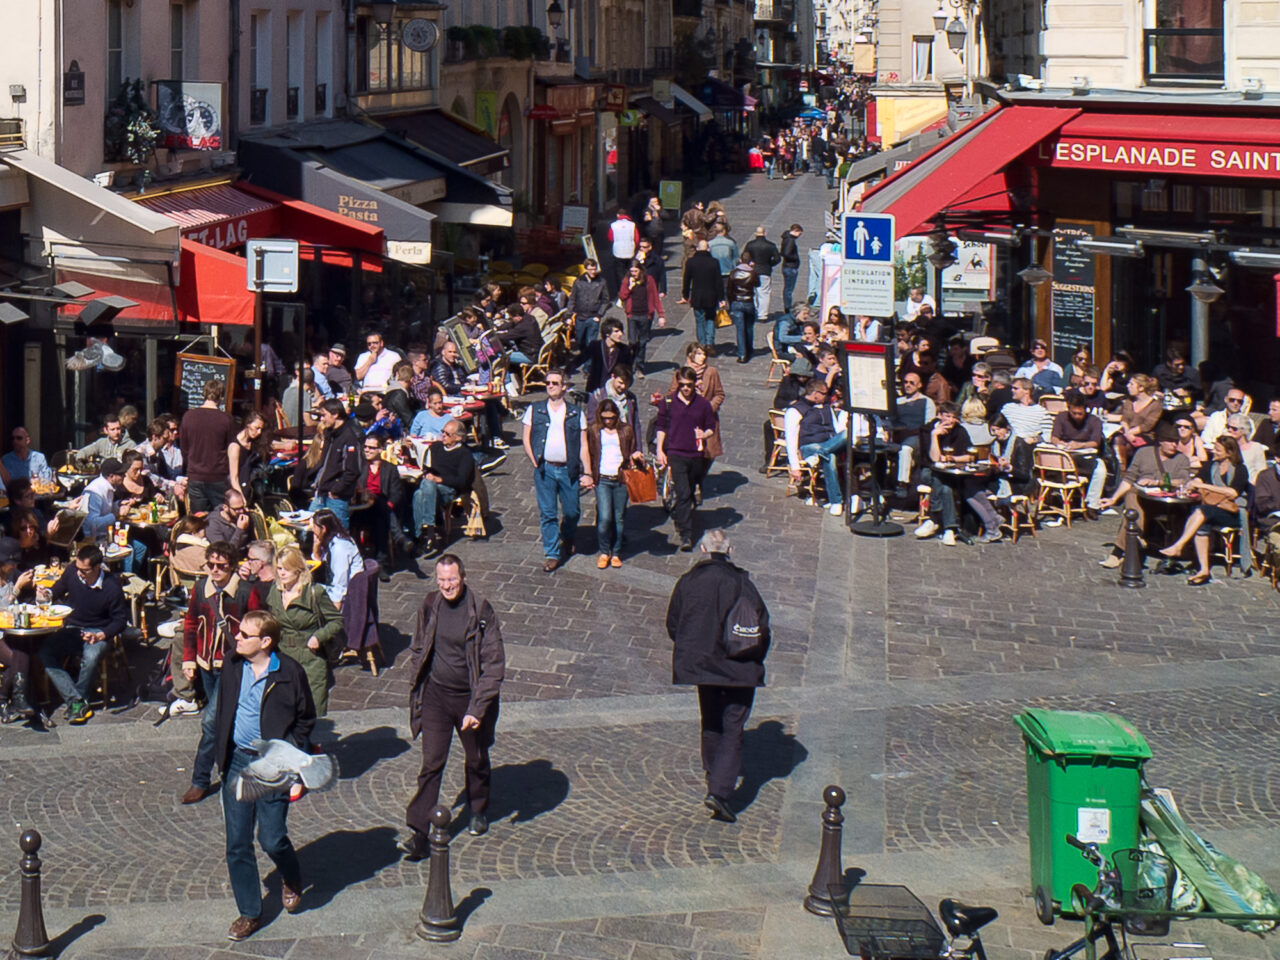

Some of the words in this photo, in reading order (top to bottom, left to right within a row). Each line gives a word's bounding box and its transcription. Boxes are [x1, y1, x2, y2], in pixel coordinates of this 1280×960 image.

[1038, 142, 1196, 167] L'ESPLANADE
[338, 195, 378, 210] Pizza
[338, 208, 378, 222] Pasta
[181, 219, 248, 249] T-LAG
[395, 245, 423, 256] Perla
[843, 268, 891, 276] CIRCULATION
[848, 278, 886, 286] INTERDITE
